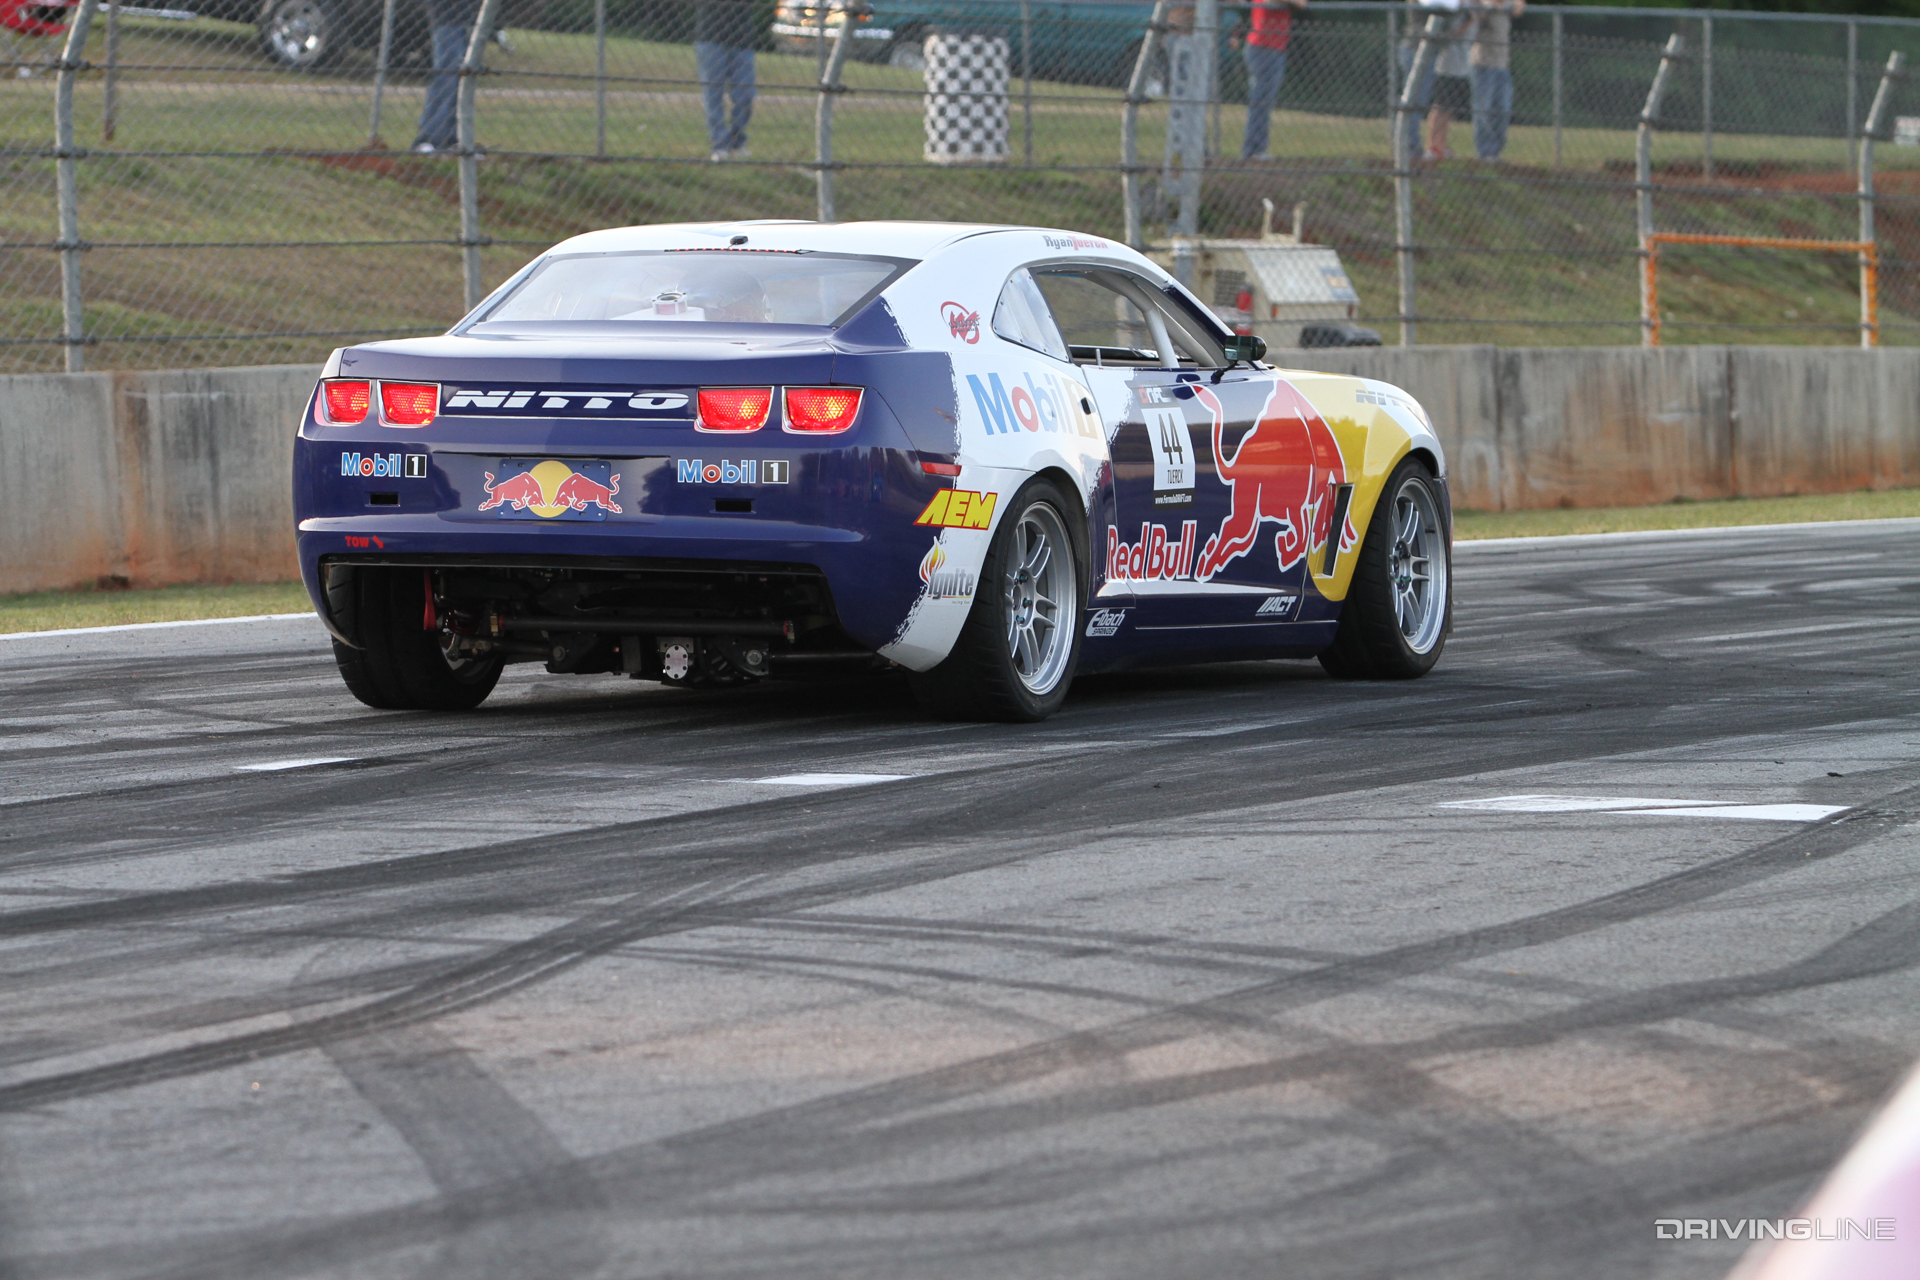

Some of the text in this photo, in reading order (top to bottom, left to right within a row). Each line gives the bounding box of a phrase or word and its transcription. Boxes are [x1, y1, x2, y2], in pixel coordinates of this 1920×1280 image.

[445, 390, 690, 410] NITTO
[964, 371, 1074, 436] Mobil
[1157, 412, 1184, 466] 44
[340, 451, 402, 478] Mobil
[677, 458, 757, 484] Mobil
[1166, 468, 1184, 485] TUERCK
[912, 487, 998, 531] AEM
[344, 535, 371, 548] TOW
[927, 566, 975, 600] ignite
